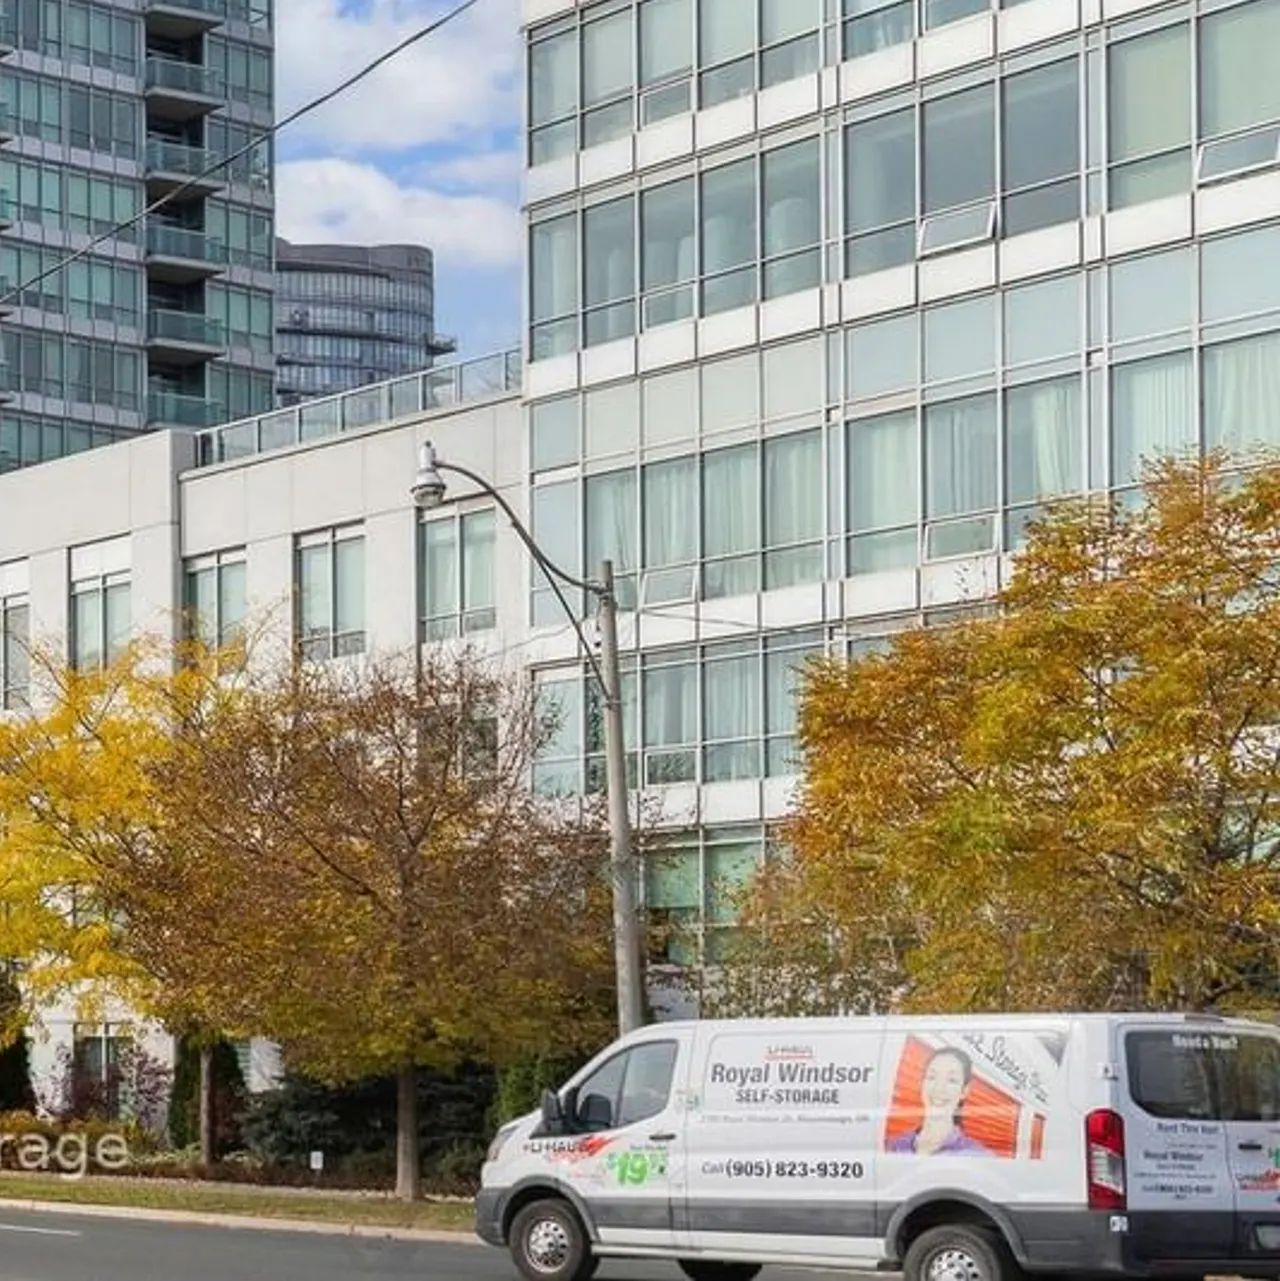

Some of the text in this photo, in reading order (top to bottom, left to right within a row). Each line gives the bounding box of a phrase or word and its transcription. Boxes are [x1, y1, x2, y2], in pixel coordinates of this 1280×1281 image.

[711, 1062, 874, 1088] Royal Windsor
[735, 1088, 840, 1104] SELF-STORAGE
[726, 1158, 772, 1179] (905)
[775, 1160, 865, 1179] 823-9320
